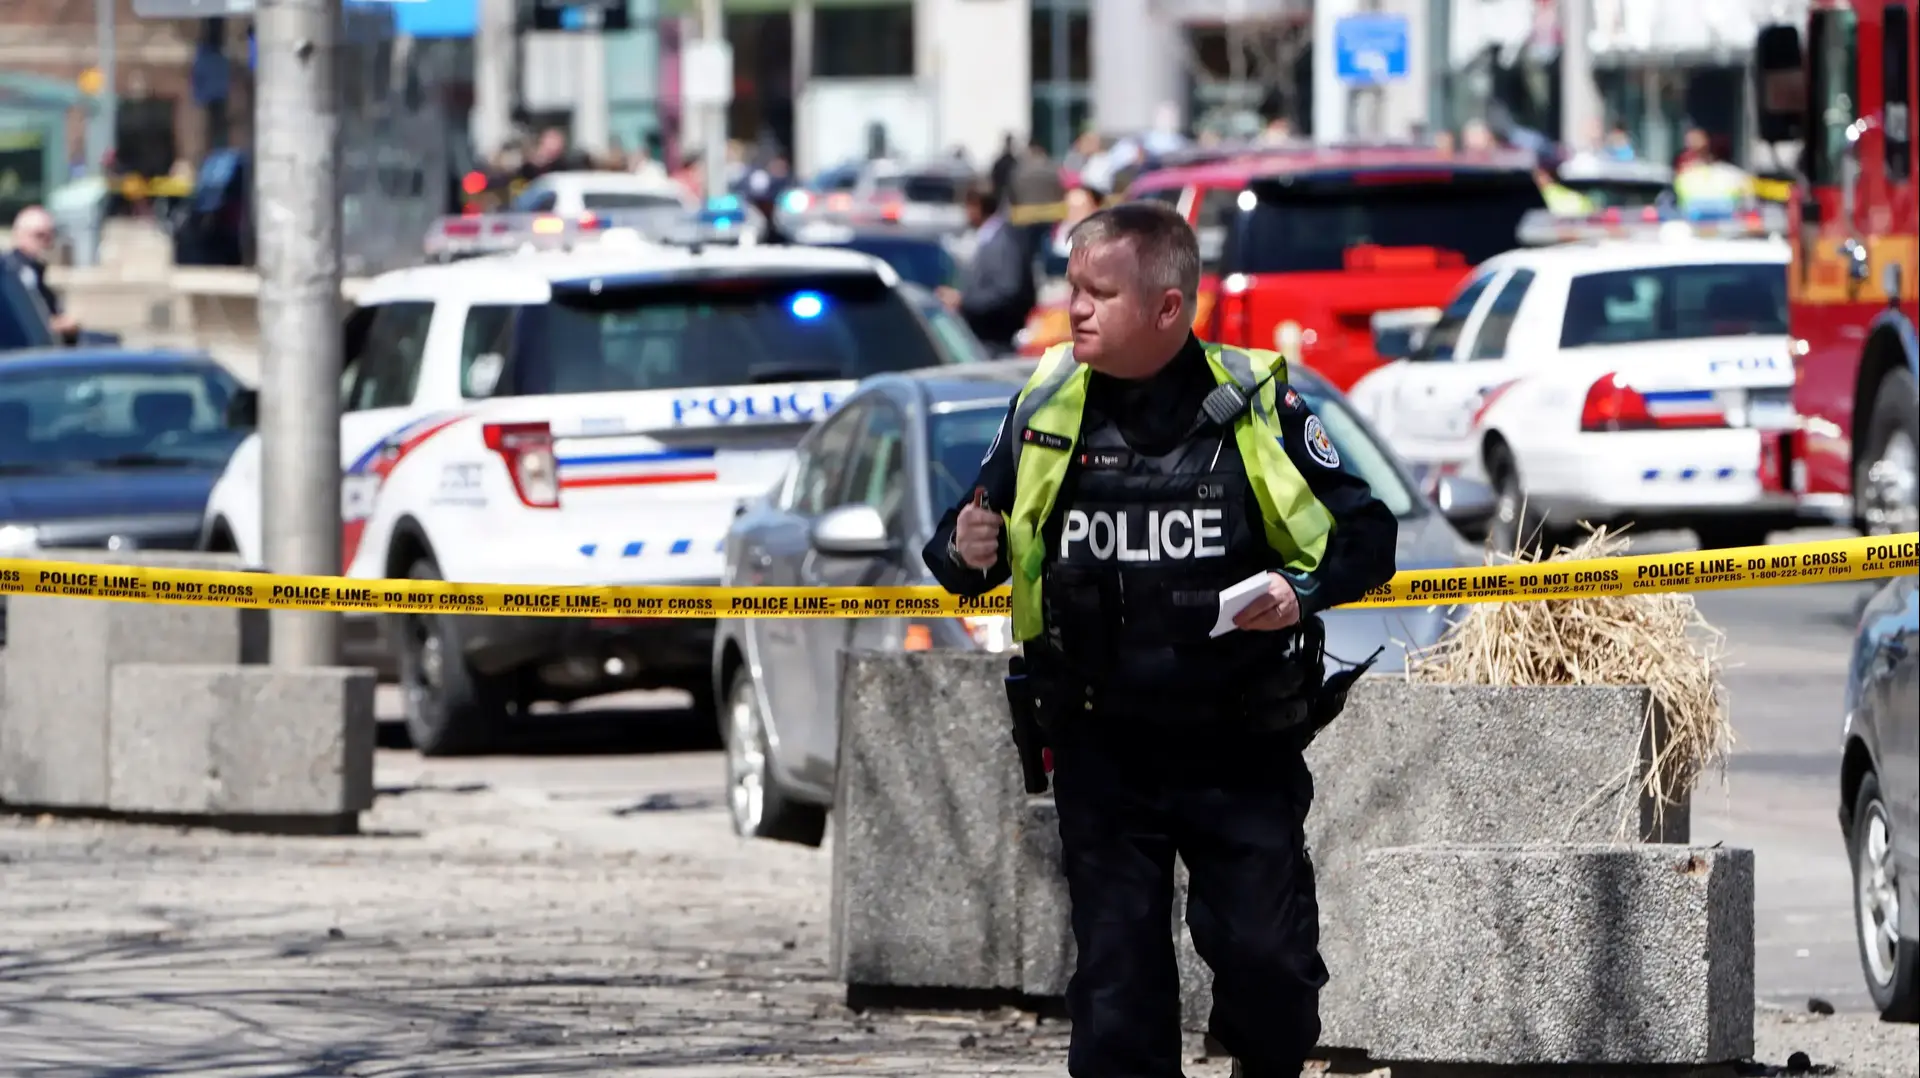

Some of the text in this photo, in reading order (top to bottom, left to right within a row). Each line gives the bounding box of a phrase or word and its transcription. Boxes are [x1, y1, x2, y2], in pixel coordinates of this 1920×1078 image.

[673, 391, 840, 424] POLICE
[1061, 508, 1226, 561] POLICE
[1638, 552, 1847, 578] POLICE LINE- DO NOT CROSS
[1862, 562, 1884, 571] CALL
[0, 570, 20, 581] SS
[40, 570, 253, 596] POLICE LINE- DO NOT CROSS
[1411, 570, 1619, 593] POLICE LINE- DO NOT CROSS
[1633, 580, 1656, 588] CALL
[1660, 577, 1690, 586] CRIME
[1751, 568, 1824, 580] 1-800-222-8477
[1828, 566, 1852, 575] (tips)
[273, 586, 484, 605] POLICE LINE- DO NOT CROSS
[1523, 584, 1596, 594] 1-800-222-8477
[1600, 582, 1623, 592] (tips)
[504, 594, 712, 609] POLICE LINE- DO NOT CROSS
[732, 597, 940, 610] POLICE LINE- DO NOT CROSS
